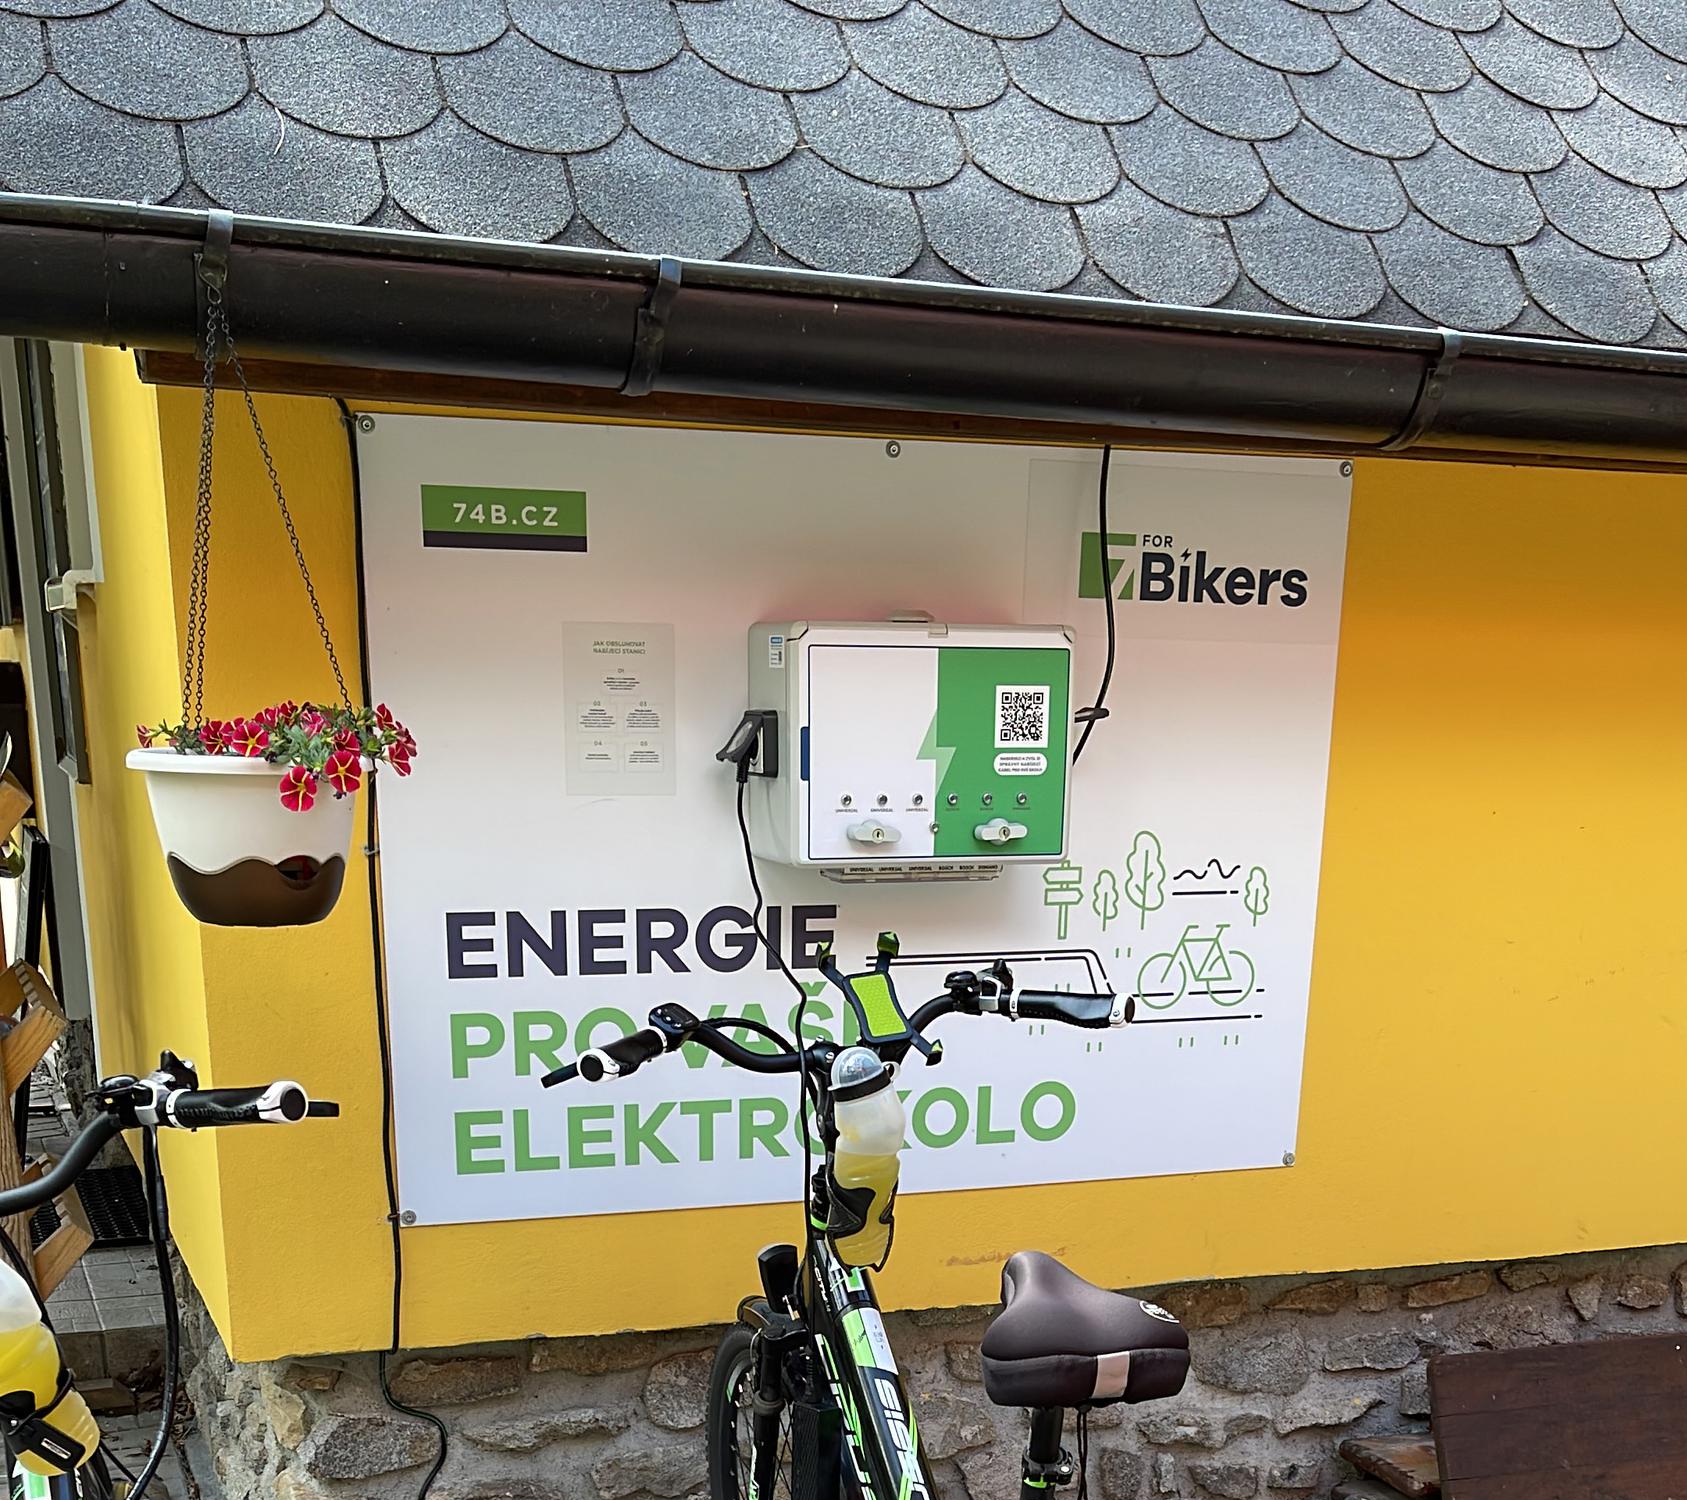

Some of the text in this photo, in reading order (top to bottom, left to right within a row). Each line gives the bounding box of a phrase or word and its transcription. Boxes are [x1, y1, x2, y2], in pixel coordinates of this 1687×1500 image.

[452, 502, 560, 528] 74B.CZ
[1142, 534, 1174, 548] FOR
[1139, 549, 1309, 608] Bikers
[446, 904, 838, 980] ENERGIE
[680, 981, 862, 1069] VAŠ
[454, 1080, 1077, 1175] ELEKTROLO
